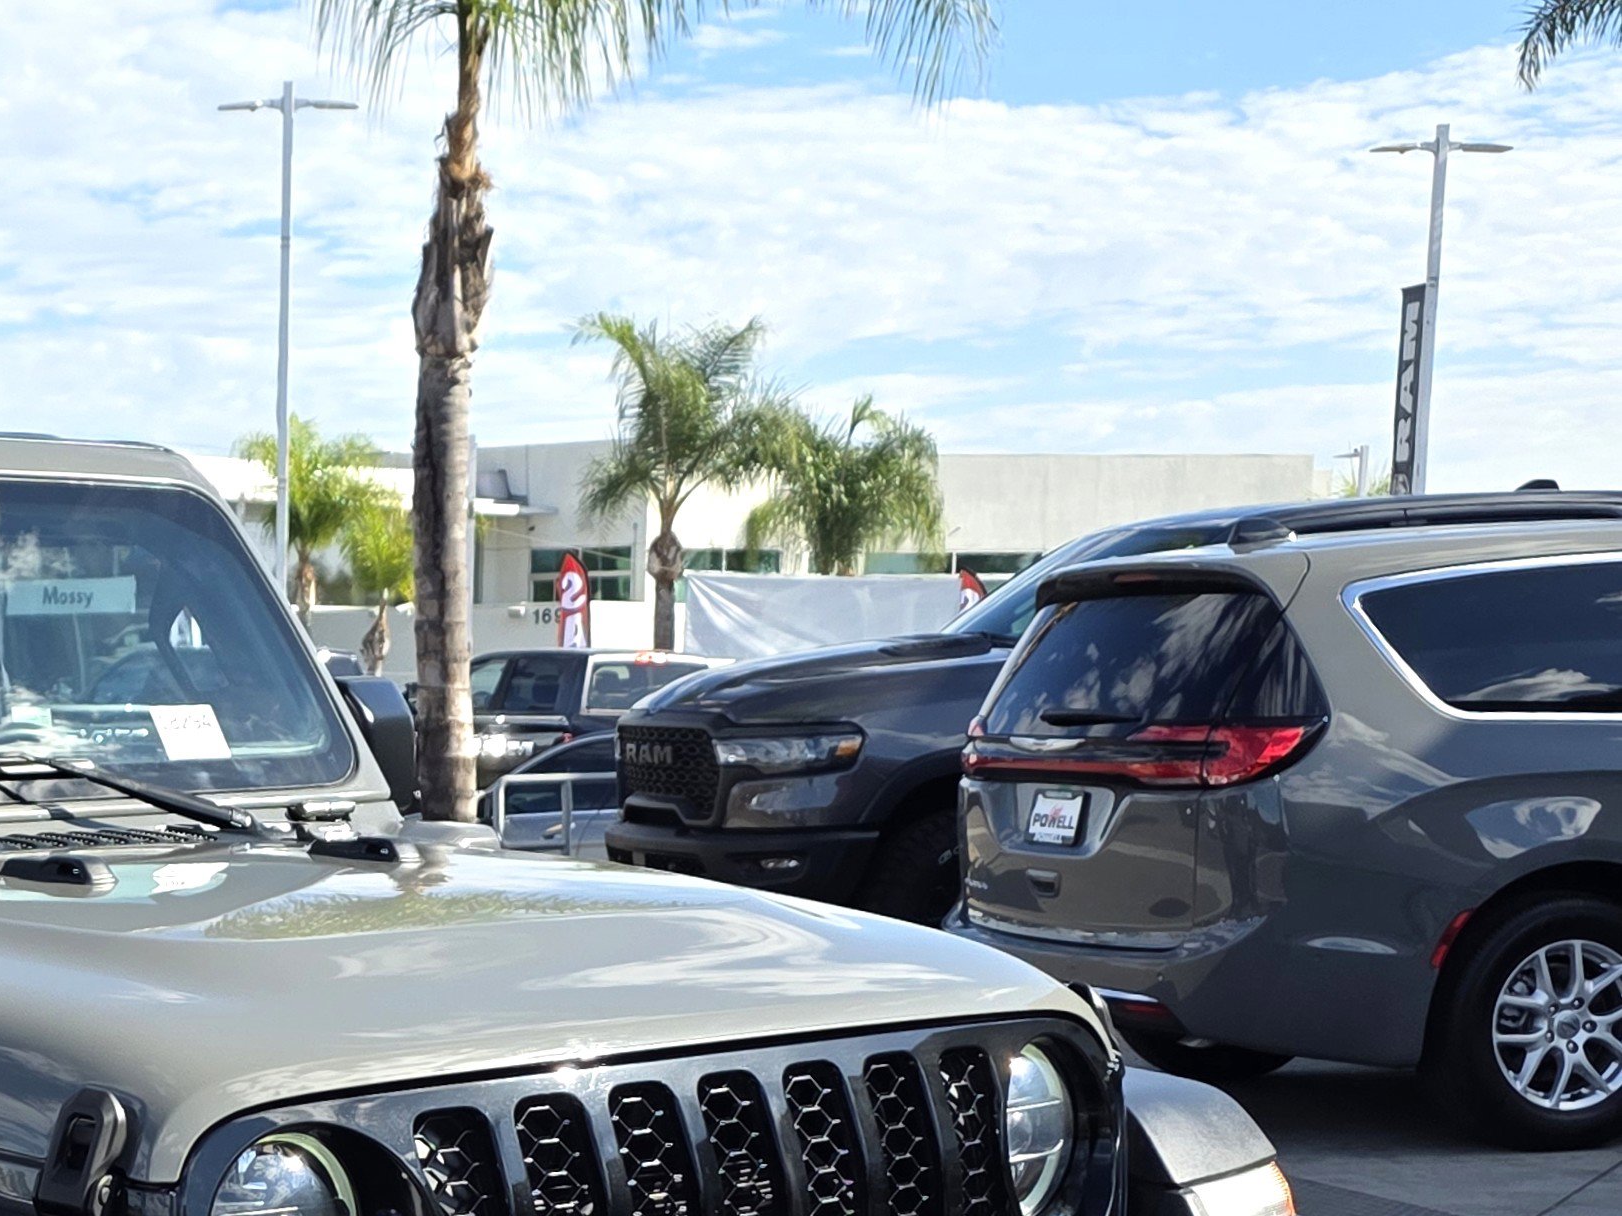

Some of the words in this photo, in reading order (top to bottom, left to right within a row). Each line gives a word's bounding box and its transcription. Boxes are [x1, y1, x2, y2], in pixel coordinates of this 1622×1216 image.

[42, 586, 94, 608] Mossy
[625, 743, 673, 764] RAM
[1032, 813, 1075, 830] POWELL
